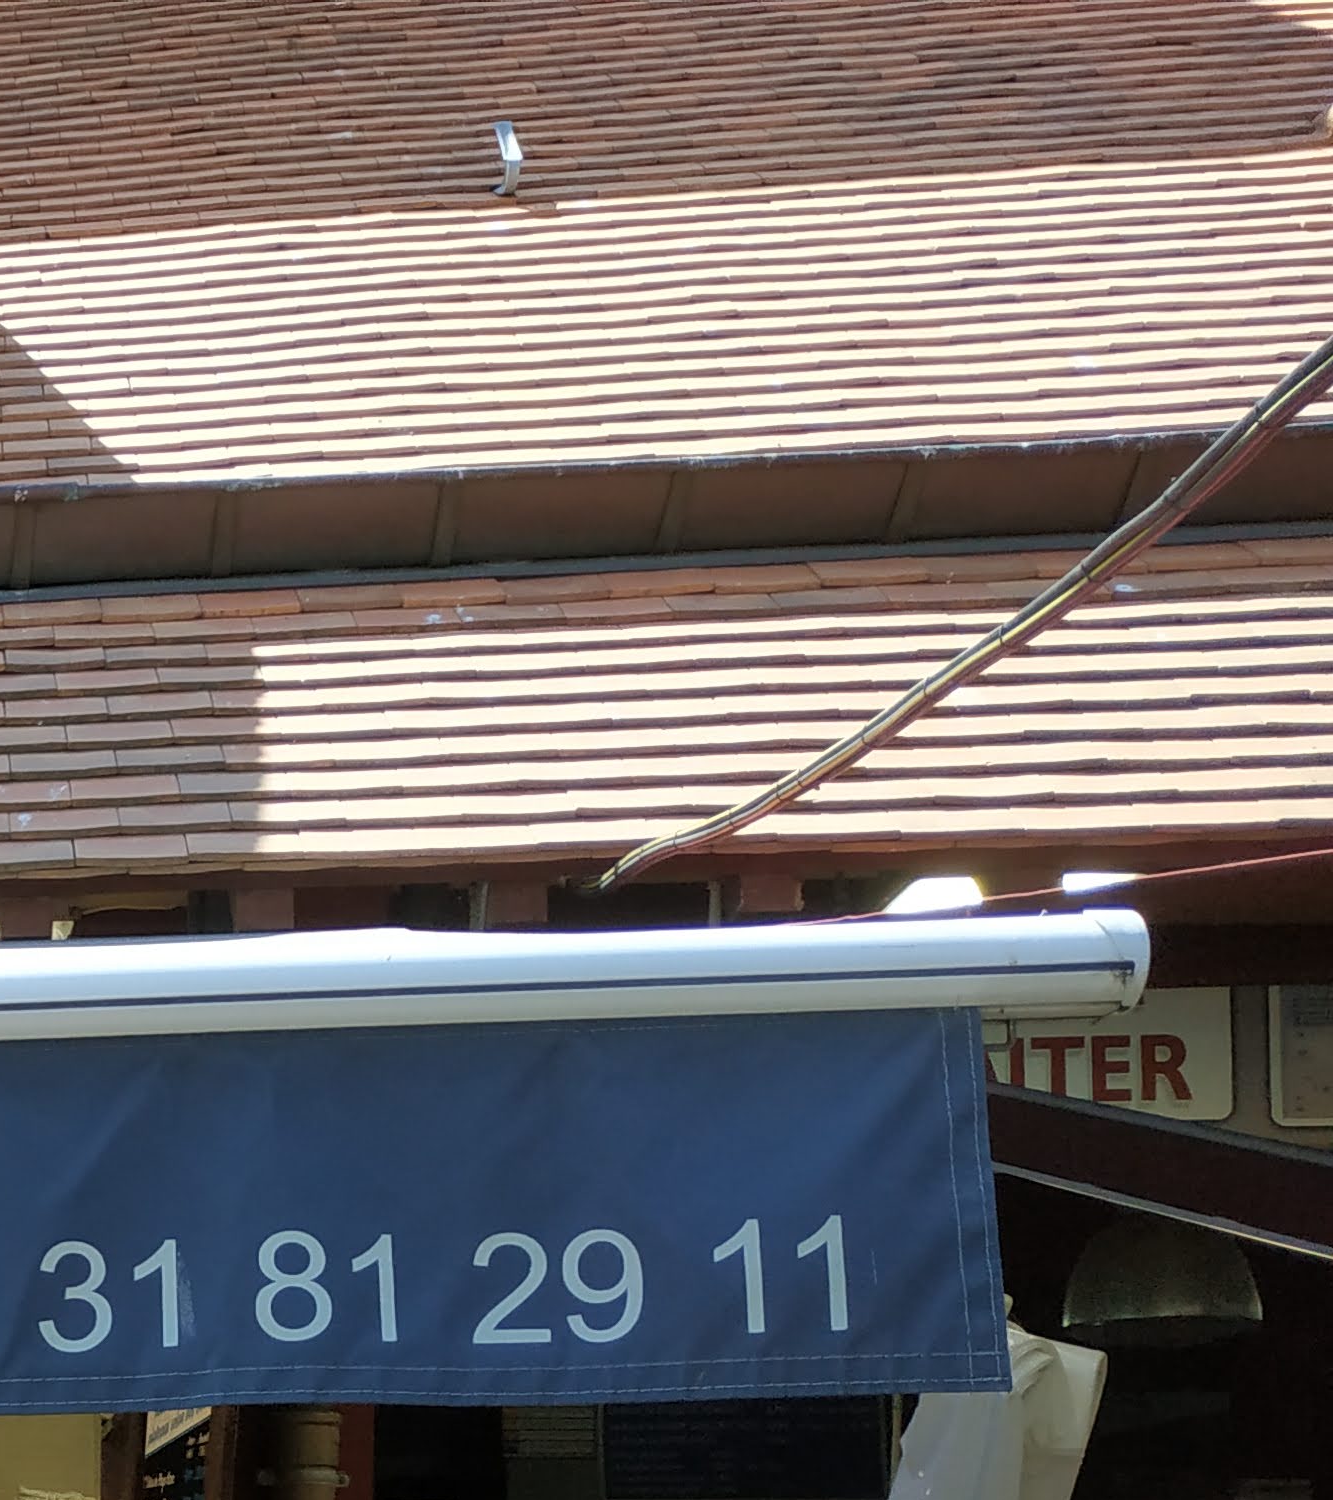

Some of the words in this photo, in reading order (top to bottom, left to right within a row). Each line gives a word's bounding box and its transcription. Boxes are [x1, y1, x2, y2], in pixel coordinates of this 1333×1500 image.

[986, 1034, 1193, 1101] ITER
[38, 1239, 178, 1353] 31
[255, 1230, 397, 1344] 81
[471, 1229, 644, 1345] 29
[712, 1214, 849, 1334] 11
